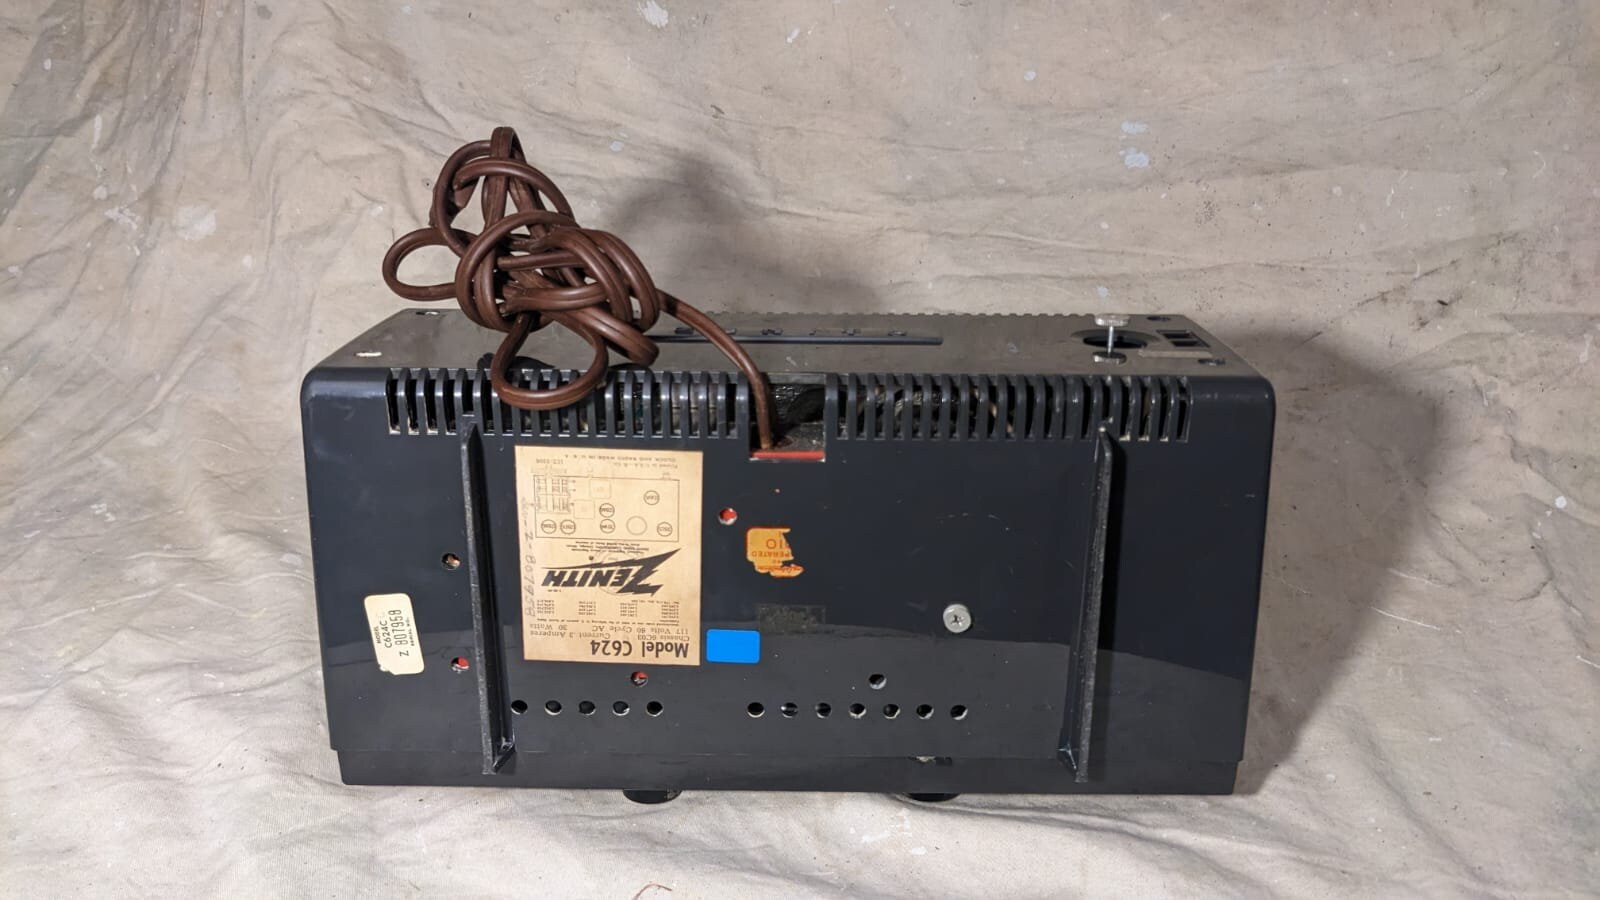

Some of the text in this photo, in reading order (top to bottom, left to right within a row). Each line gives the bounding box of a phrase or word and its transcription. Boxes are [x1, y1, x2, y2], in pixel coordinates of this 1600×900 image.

[540, 548, 681, 596] ZENITH
[380, 620, 392, 648] C624C
[388, 609, 408, 646] 807958
[529, 630, 565, 638] Amperes
[608, 625, 633, 633] Cycle
[590, 639, 689, 658] Model C624
